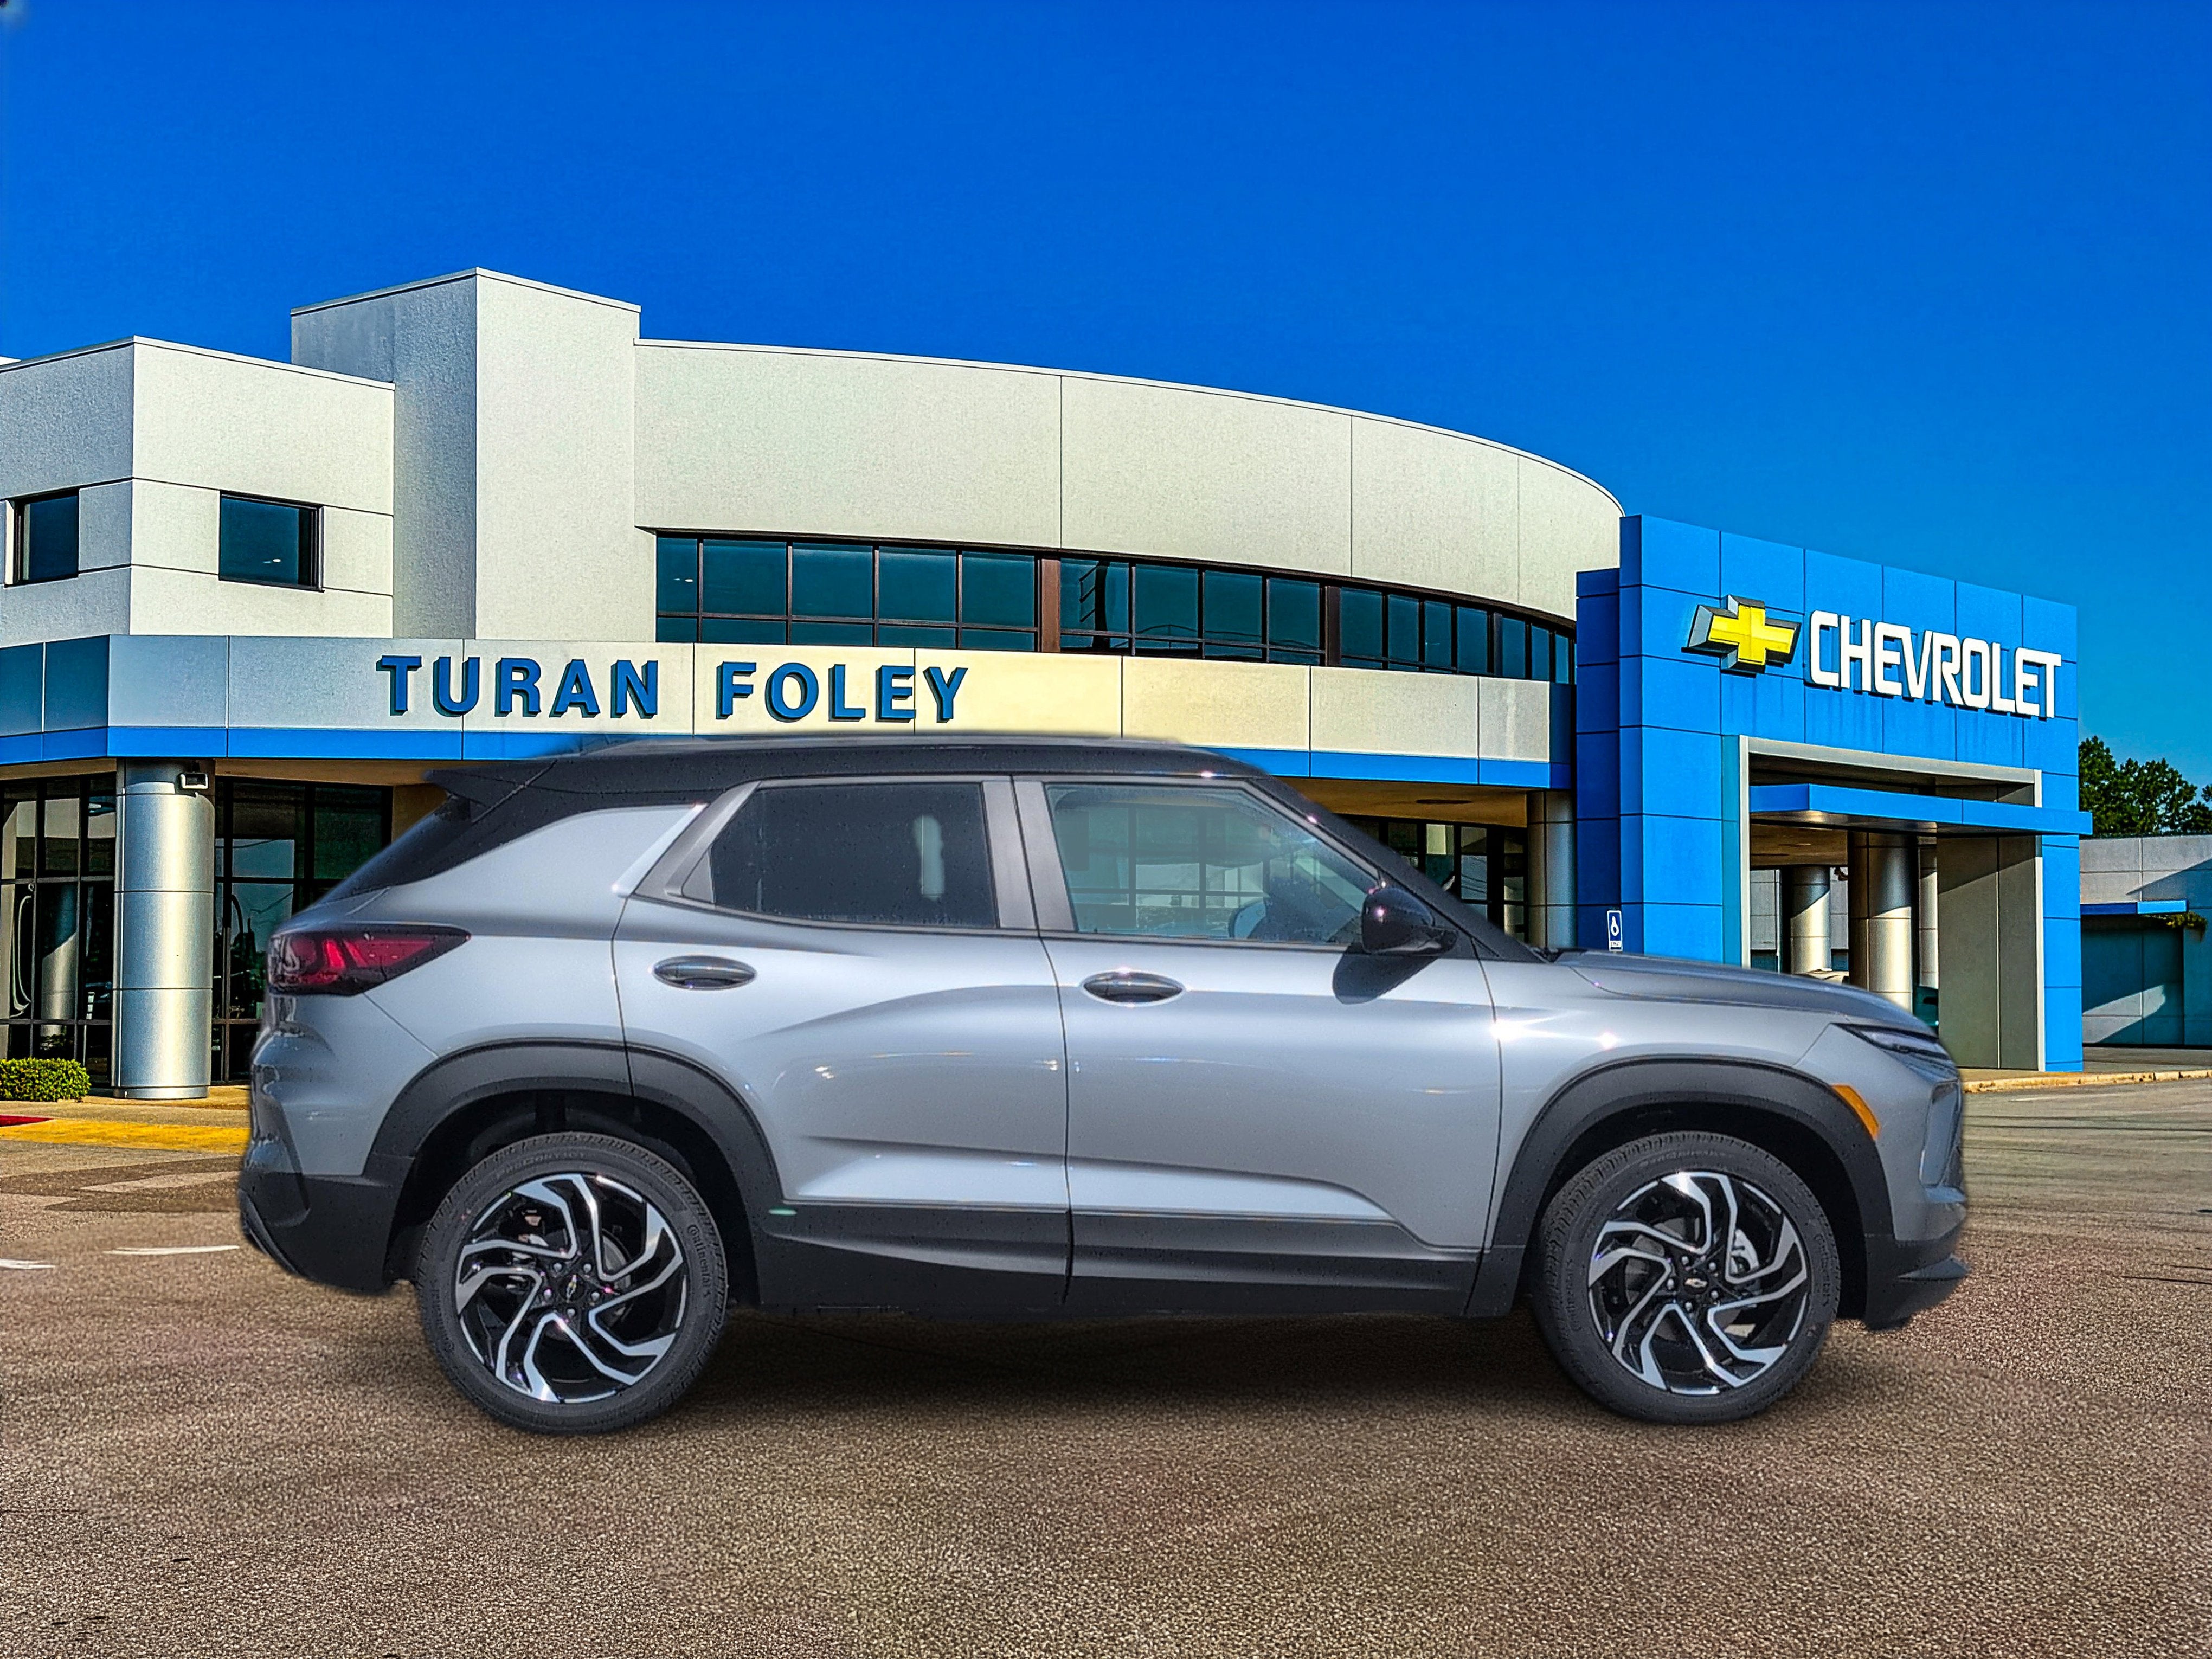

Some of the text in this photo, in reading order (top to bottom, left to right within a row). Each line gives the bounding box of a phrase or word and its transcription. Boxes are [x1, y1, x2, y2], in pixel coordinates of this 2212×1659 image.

[376, 655, 969, 723] TURAN FOLEY
[1809, 610, 2062, 718] CHEVROLET
